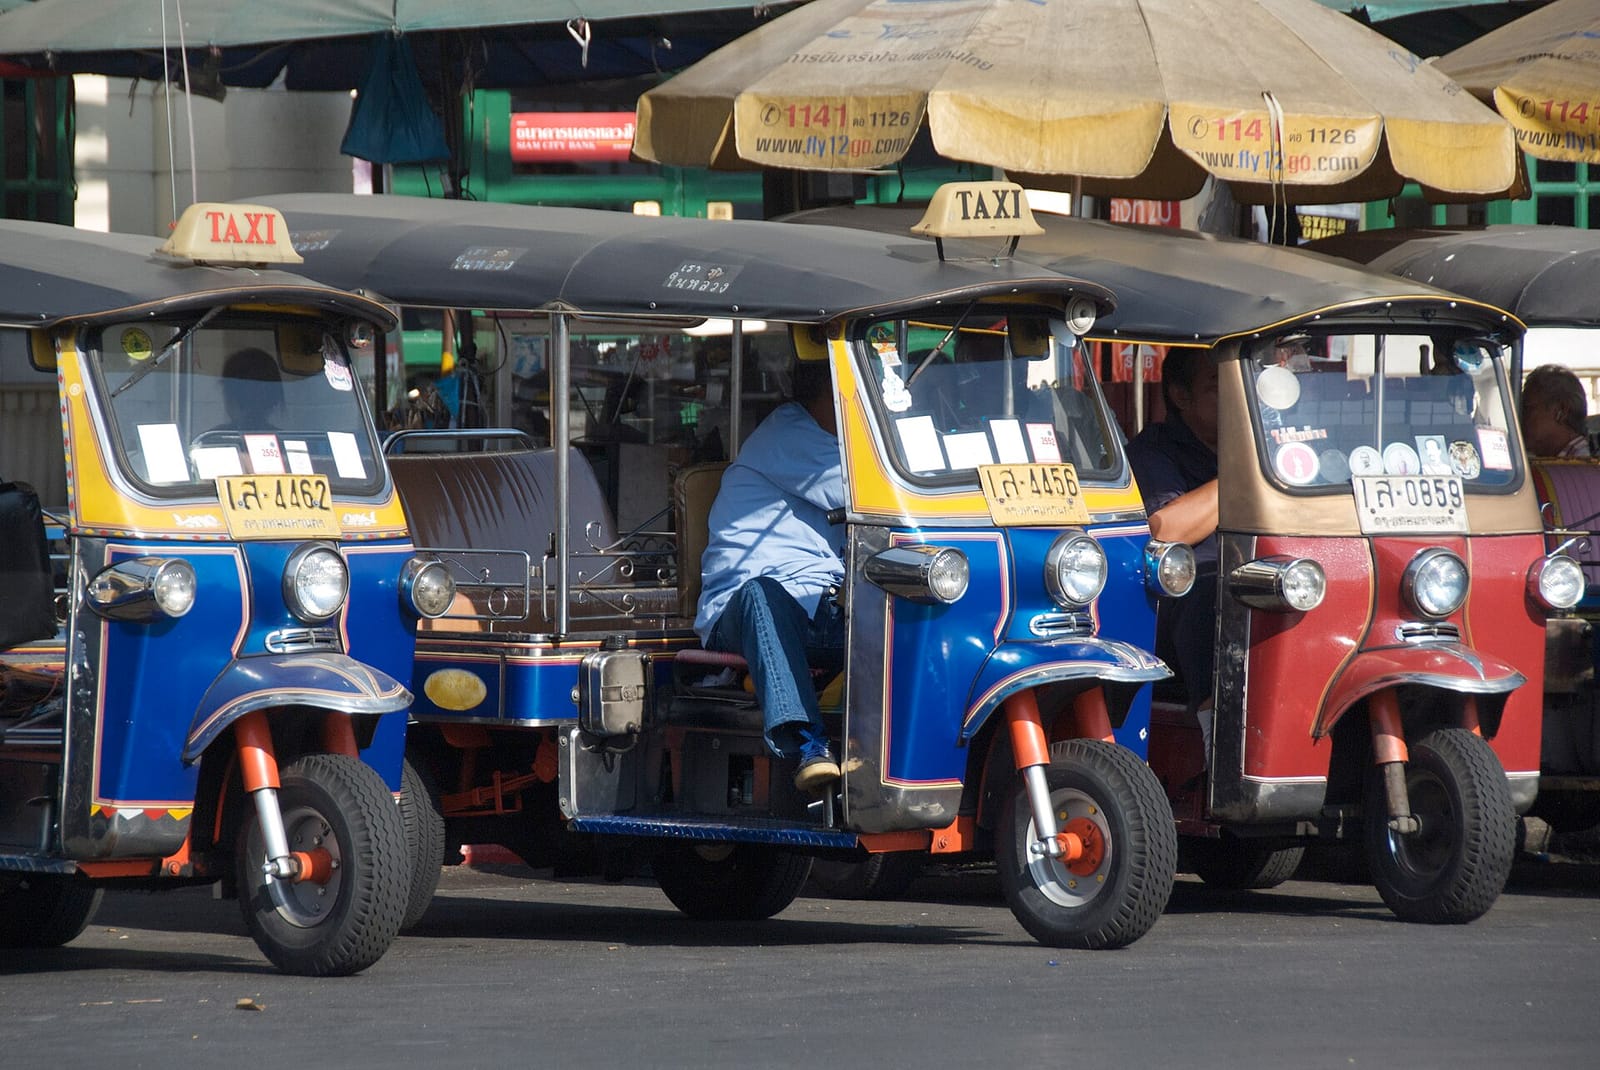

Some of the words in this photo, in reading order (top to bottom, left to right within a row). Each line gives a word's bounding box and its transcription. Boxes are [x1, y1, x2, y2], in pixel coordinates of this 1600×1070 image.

[783, 103, 847, 128] 1141
[870, 111, 911, 127] 1126
[516, 123, 636, 140] ธนาคารนครหลวงไ
[1307, 128, 1356, 144] 1126
[516, 141, 541, 150] SIAM
[542, 141, 565, 150] CITY
[568, 141, 596, 150] BANK
[756, 134, 905, 158] www.fly12go.com
[1515, 131, 1600, 153] www.fly1
[955, 189, 1022, 220] TAXI
[205, 211, 277, 245] TAXI
[1302, 227, 1345, 240] UNIO
[262, 448, 279, 458] 2552
